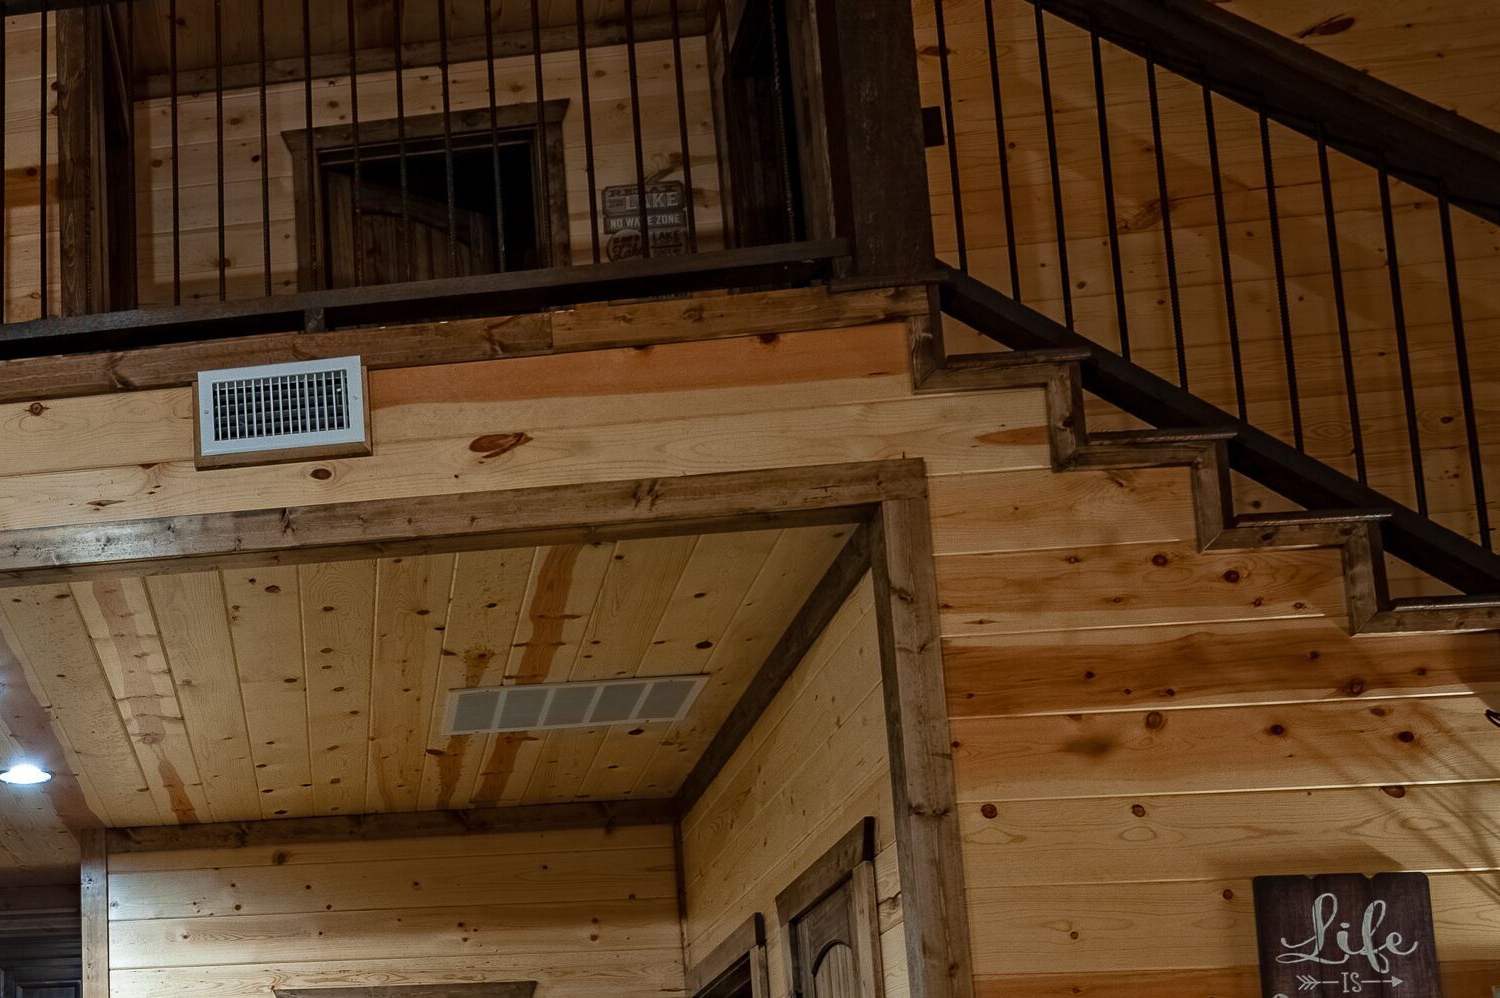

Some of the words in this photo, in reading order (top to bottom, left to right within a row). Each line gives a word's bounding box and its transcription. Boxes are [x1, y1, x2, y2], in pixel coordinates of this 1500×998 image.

[610, 218, 623, 228] NO
[626, 215, 653, 228] WAE
[656, 213, 680, 225] ZONE
[612, 243, 644, 260] Lak
[1276, 892, 1419, 974] Life
[1341, 972, 1363, 993] IS
